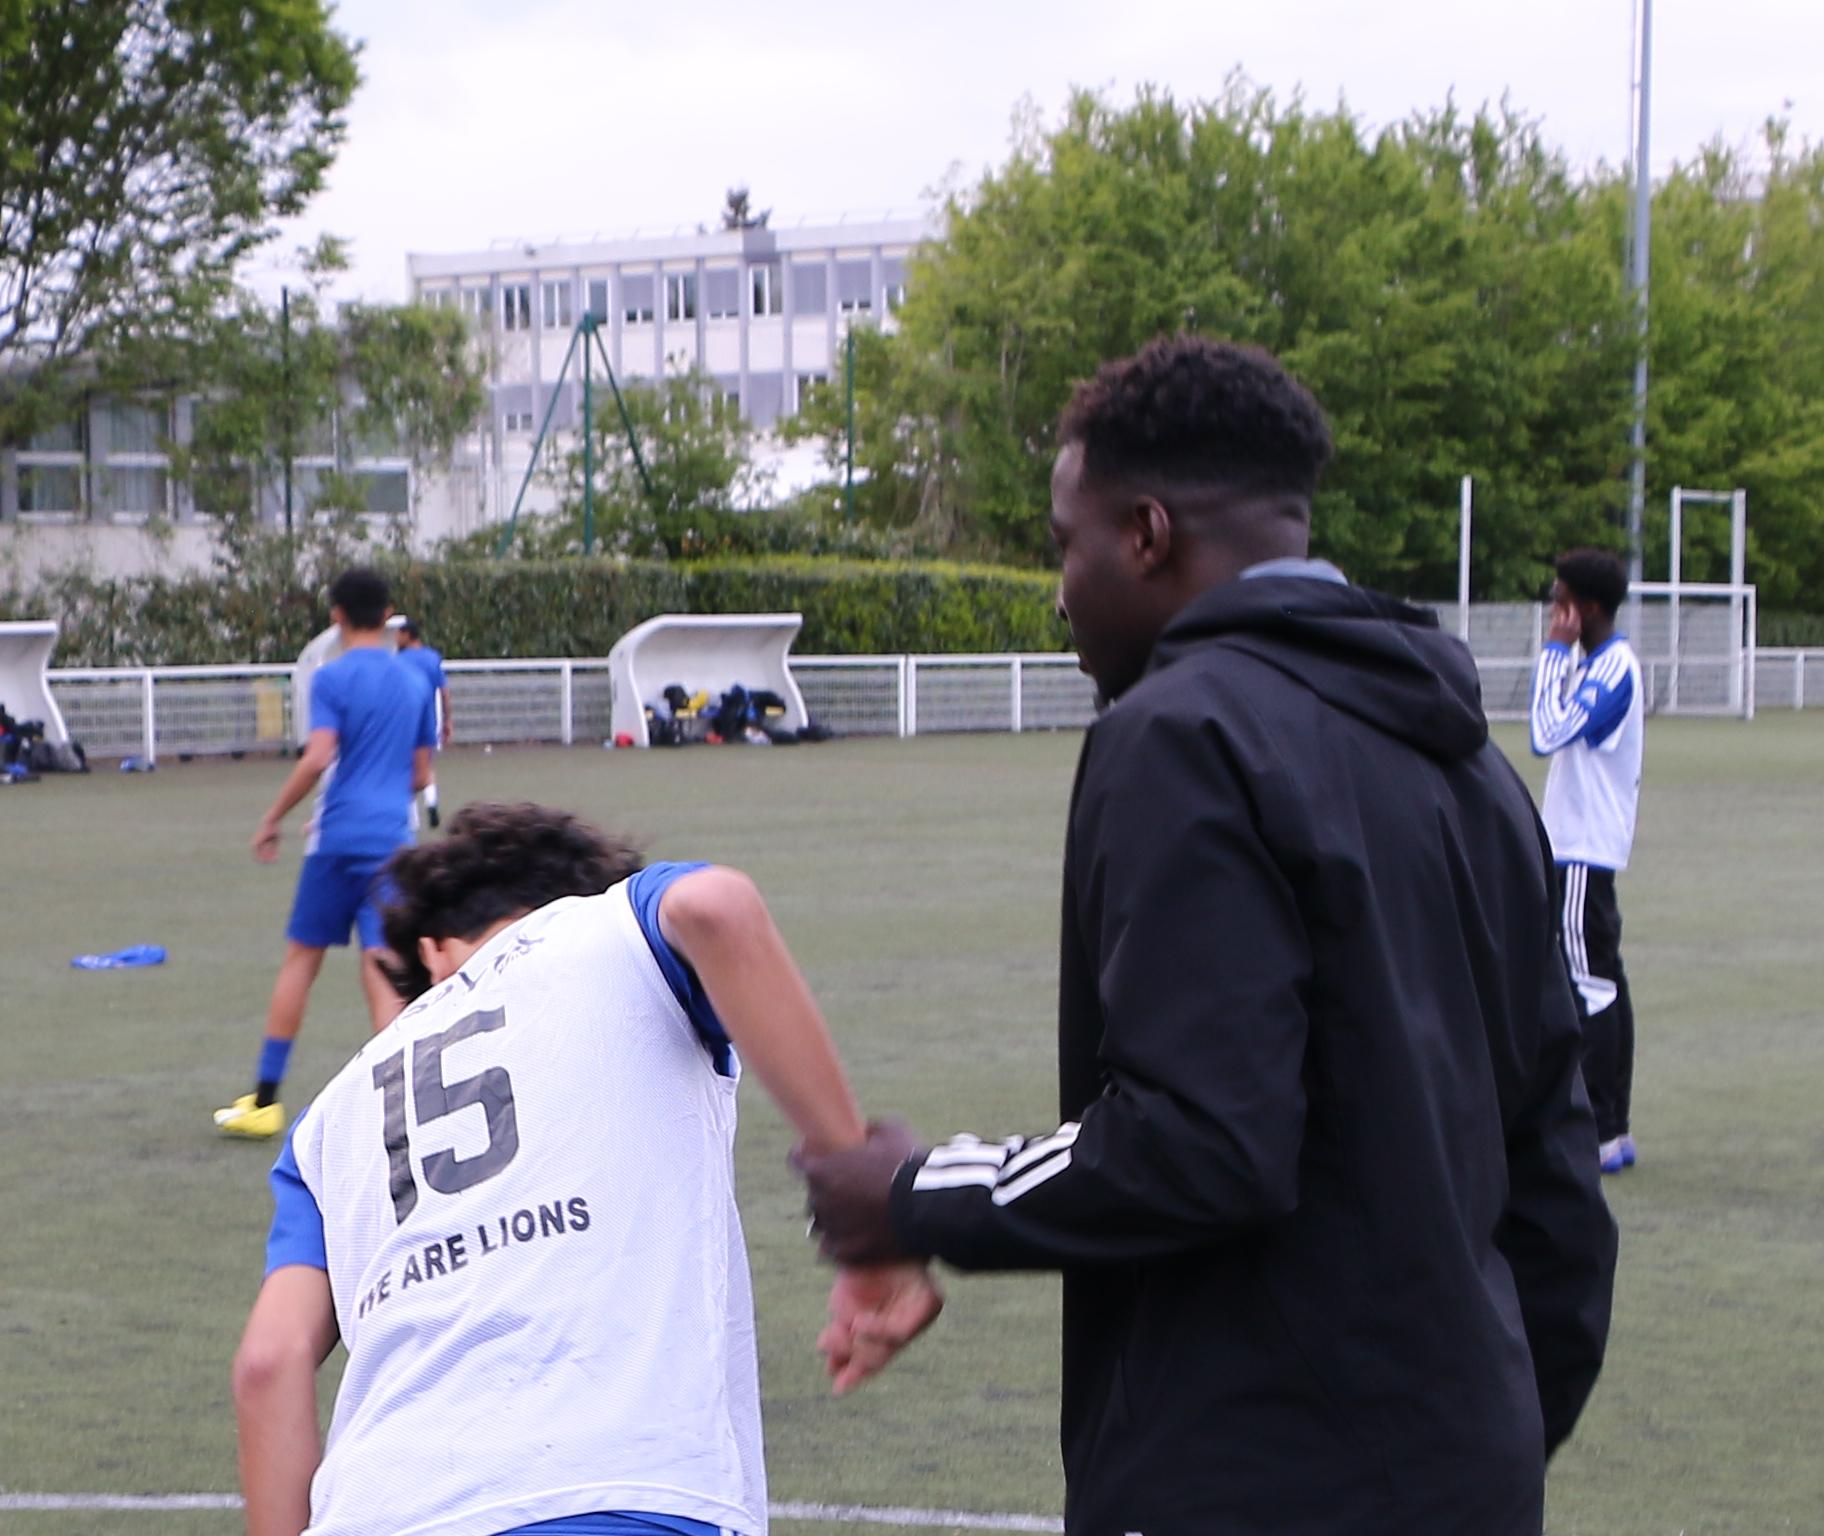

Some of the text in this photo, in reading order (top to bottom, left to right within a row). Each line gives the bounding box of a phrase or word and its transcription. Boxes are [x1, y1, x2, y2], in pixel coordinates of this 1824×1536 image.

[372, 1005, 520, 1226] 15
[402, 1233, 469, 1291] ARE
[477, 1196, 592, 1257] LIONS
